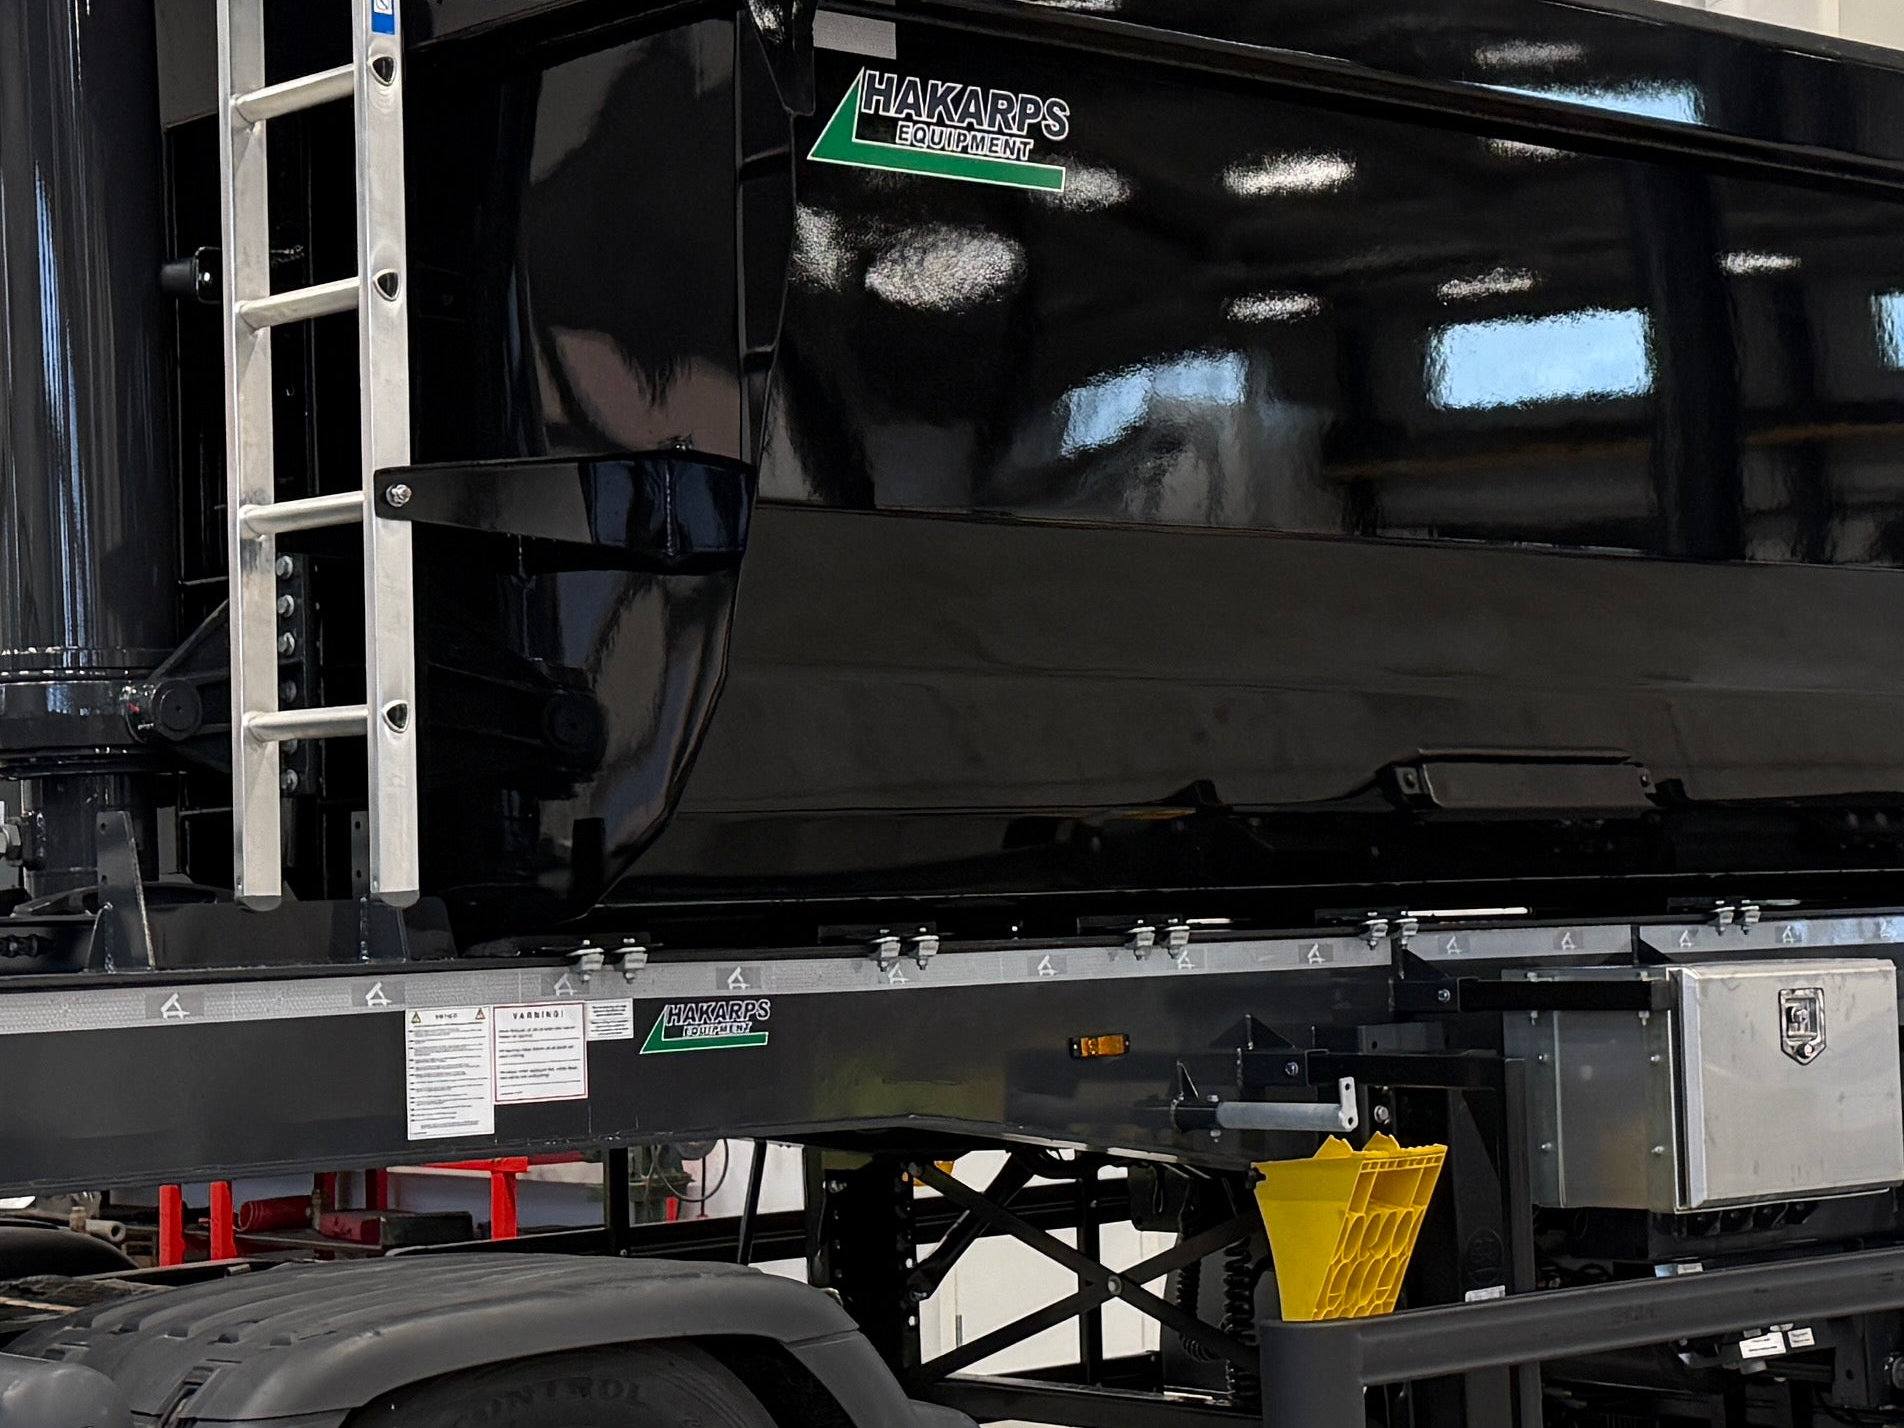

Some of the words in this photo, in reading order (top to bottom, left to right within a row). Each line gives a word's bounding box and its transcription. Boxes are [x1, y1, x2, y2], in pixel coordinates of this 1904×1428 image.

[861, 69, 1070, 141] HAKARPS
[895, 120, 1034, 161] EQUIPMENT
[665, 999, 771, 1027] HAKARPS
